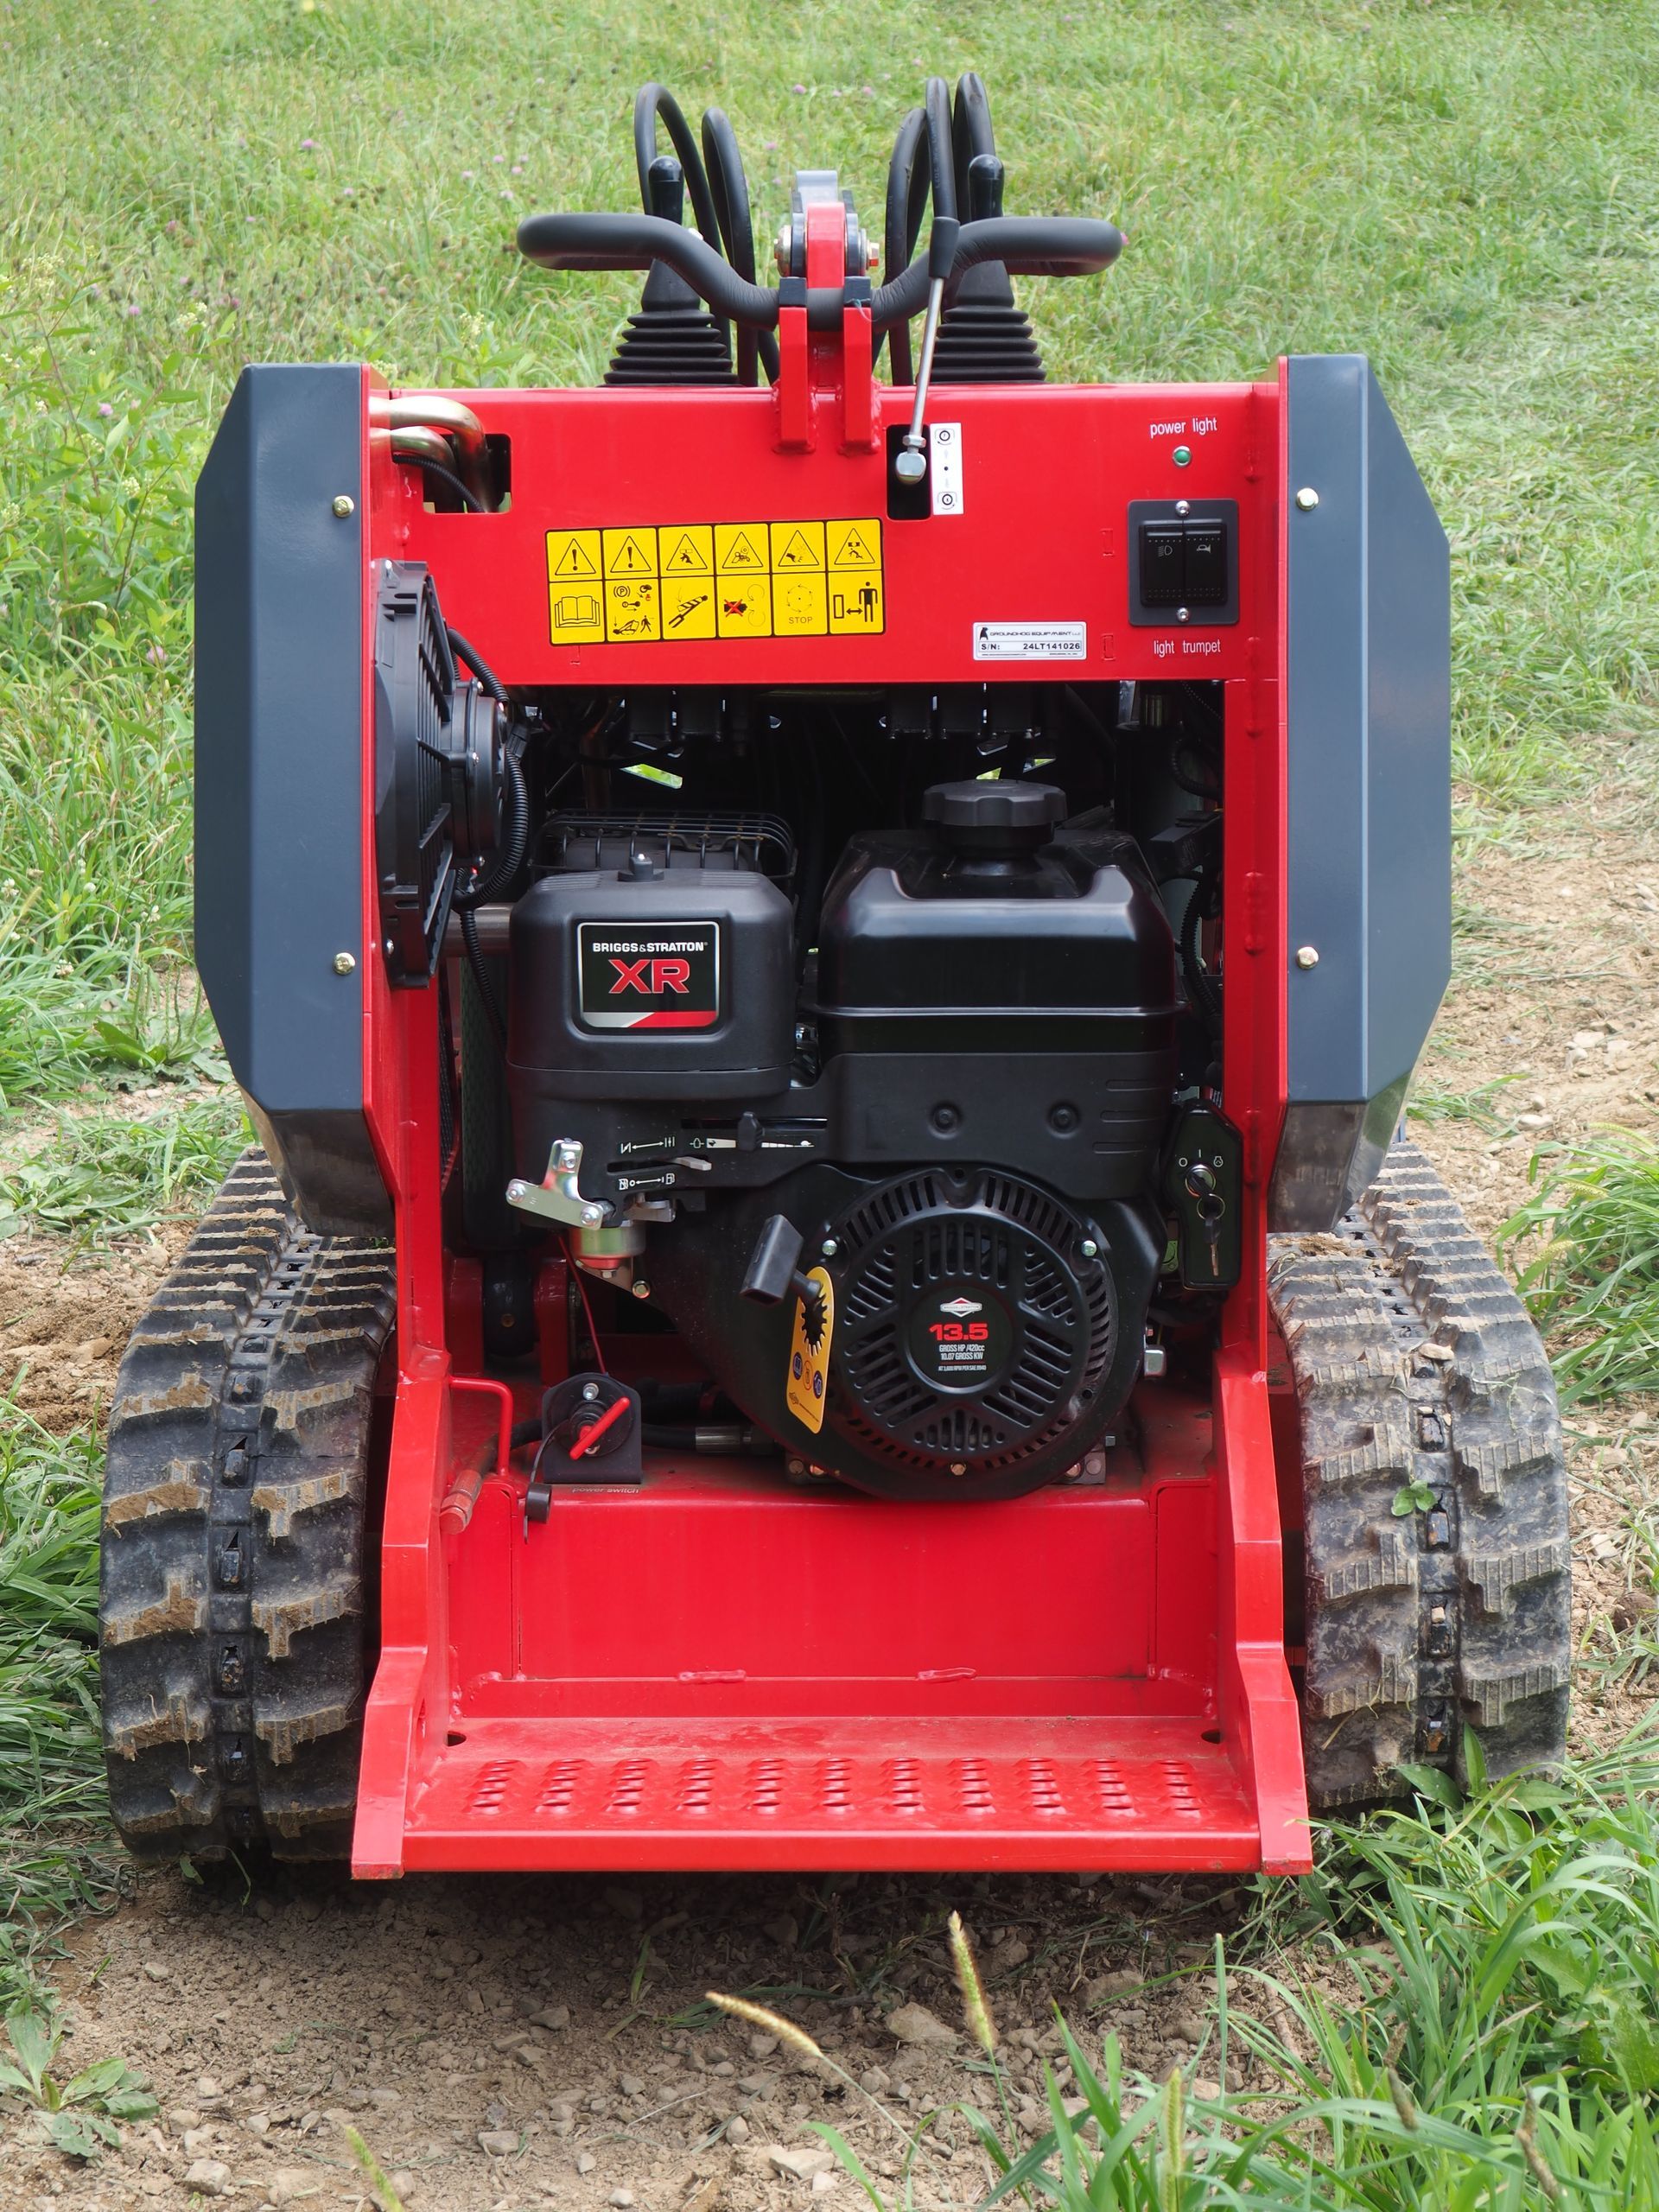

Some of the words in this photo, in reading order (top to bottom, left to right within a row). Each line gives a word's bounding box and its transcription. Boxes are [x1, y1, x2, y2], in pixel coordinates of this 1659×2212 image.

[1149, 423, 1186, 439] power
[1192, 417, 1217, 435] light
[788, 616, 813, 625] STOP
[1023, 642, 1080, 651] 24LT141026
[1154, 640, 1175, 658] light
[1182, 639, 1221, 657] trumpet
[608, 959, 690, 994] XR
[929, 1323, 988, 1341] 13.5
[939, 1344, 957, 1352] GROSS
[957, 1344, 966, 1352] HP
[940, 1352, 955, 1361] 10.07
[974, 1351, 984, 1360] KW
